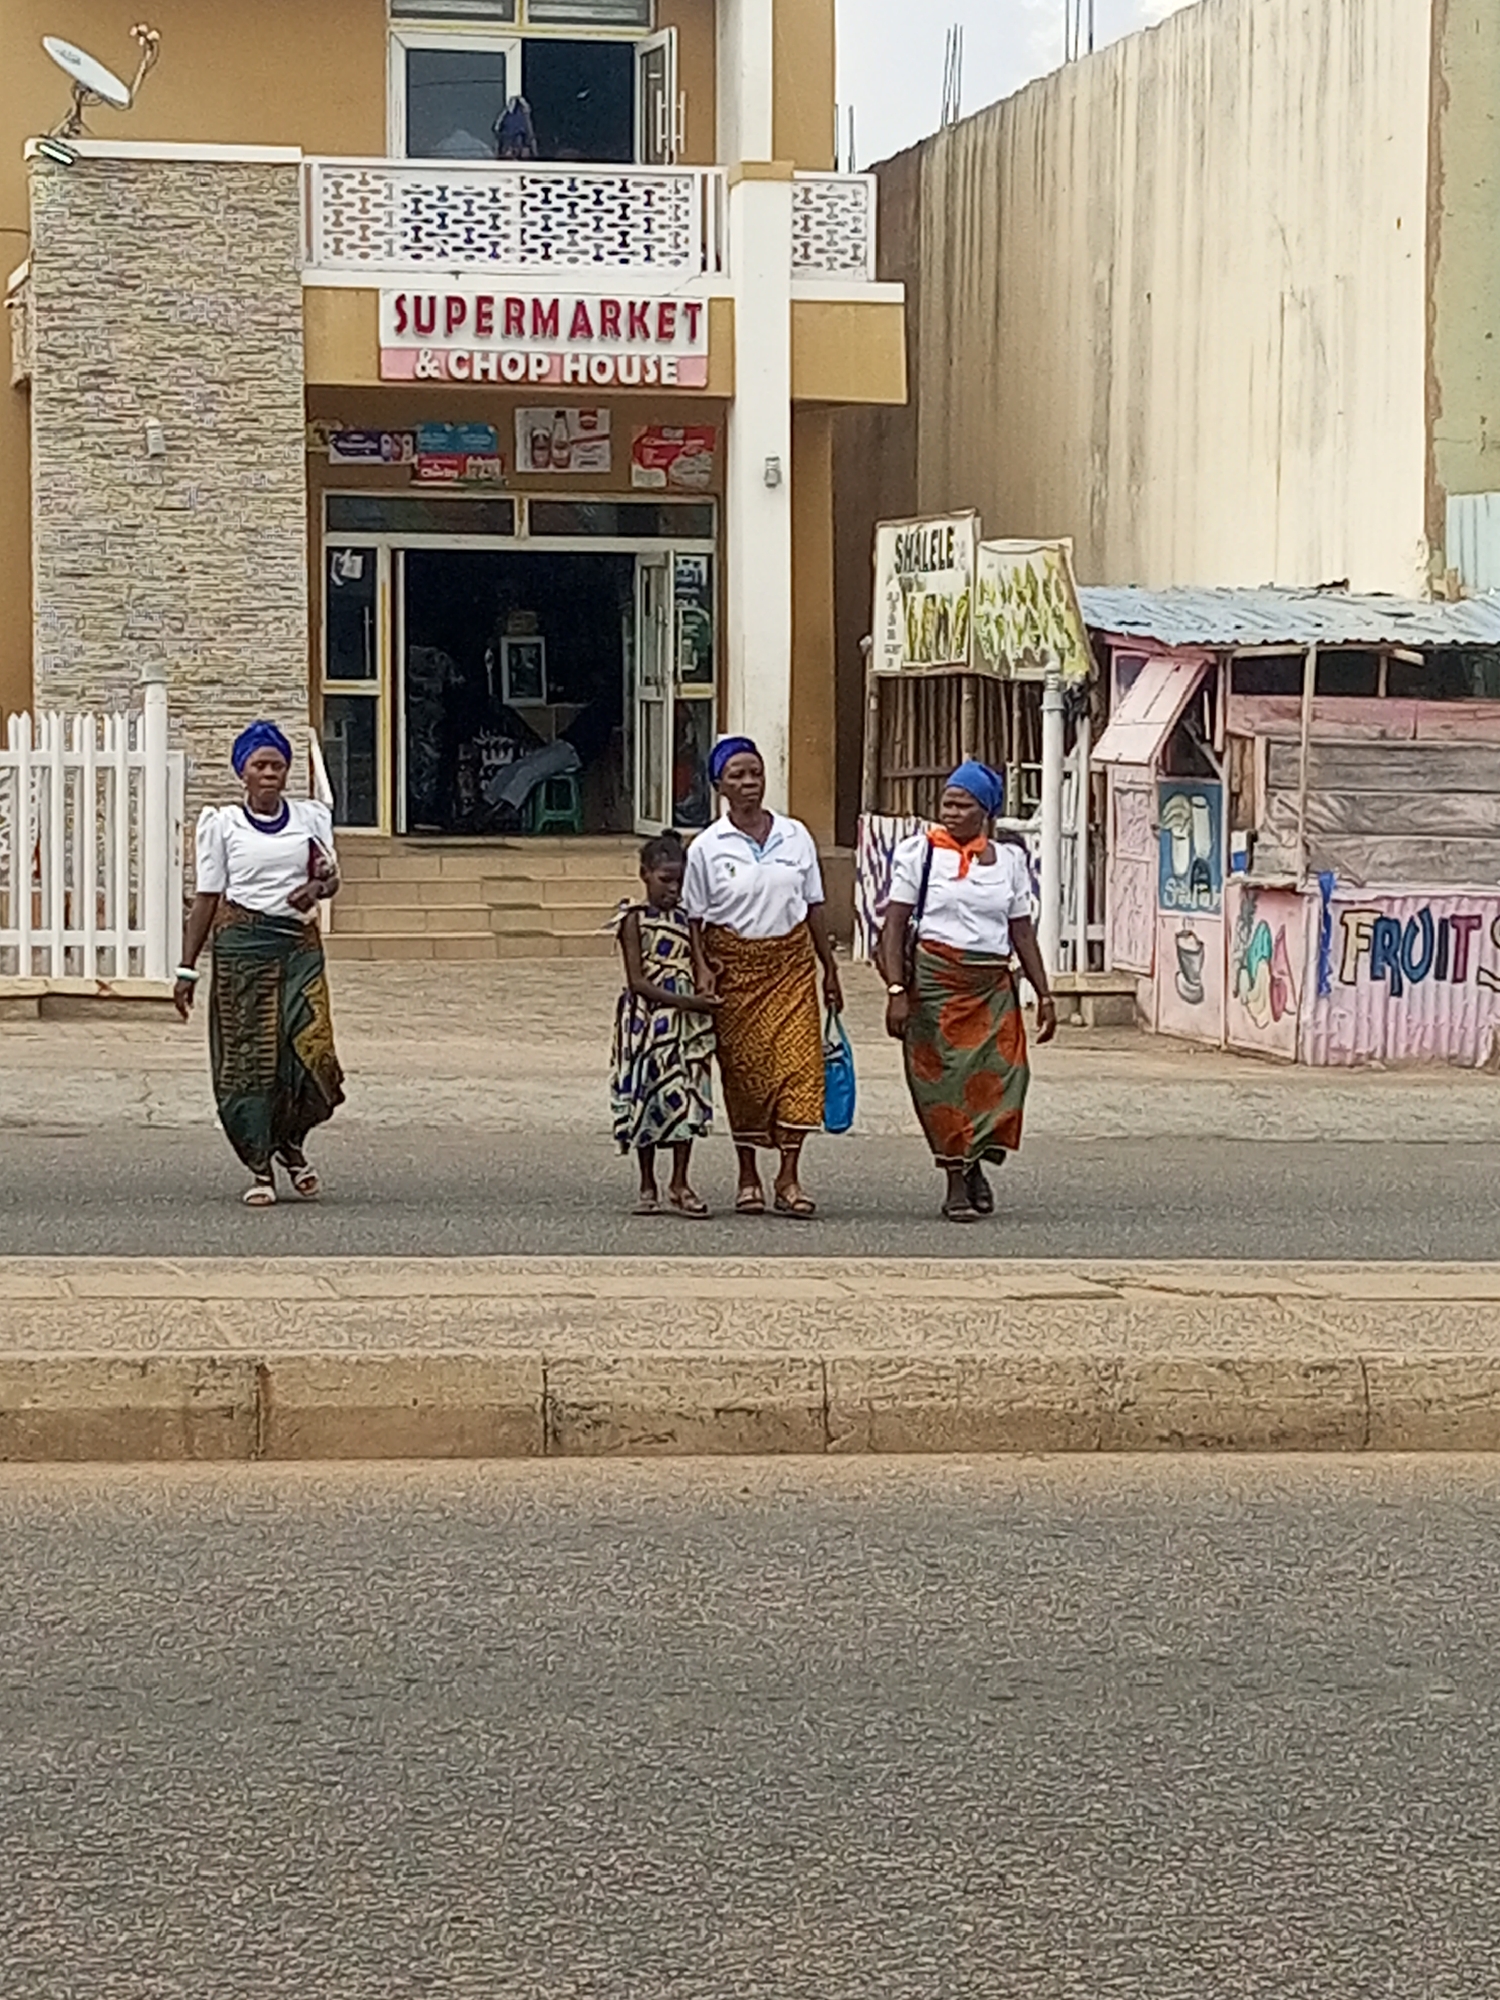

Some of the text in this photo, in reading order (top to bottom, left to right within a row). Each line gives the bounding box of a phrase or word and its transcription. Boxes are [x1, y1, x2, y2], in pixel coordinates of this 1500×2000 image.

[394, 294, 703, 342] SUPERMARKET
[415, 348, 678, 385] & CHOP HOUSE
